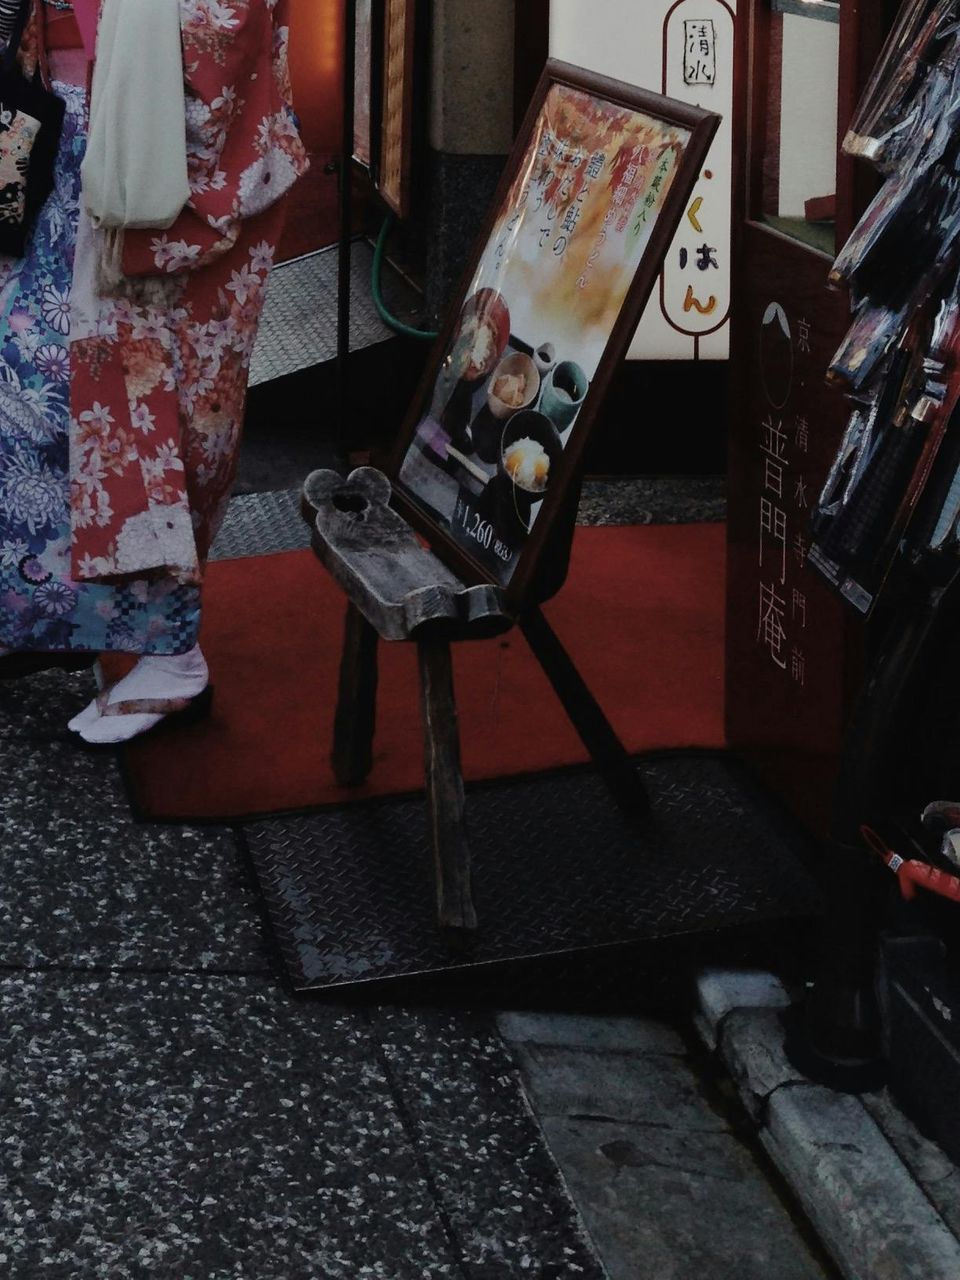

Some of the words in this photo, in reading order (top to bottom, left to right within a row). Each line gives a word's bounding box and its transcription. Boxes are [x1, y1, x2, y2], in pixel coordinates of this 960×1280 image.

[688, 24, 712, 81] 清水
[679, 169, 719, 315] くはん
[757, 414, 788, 670] 普門庵
